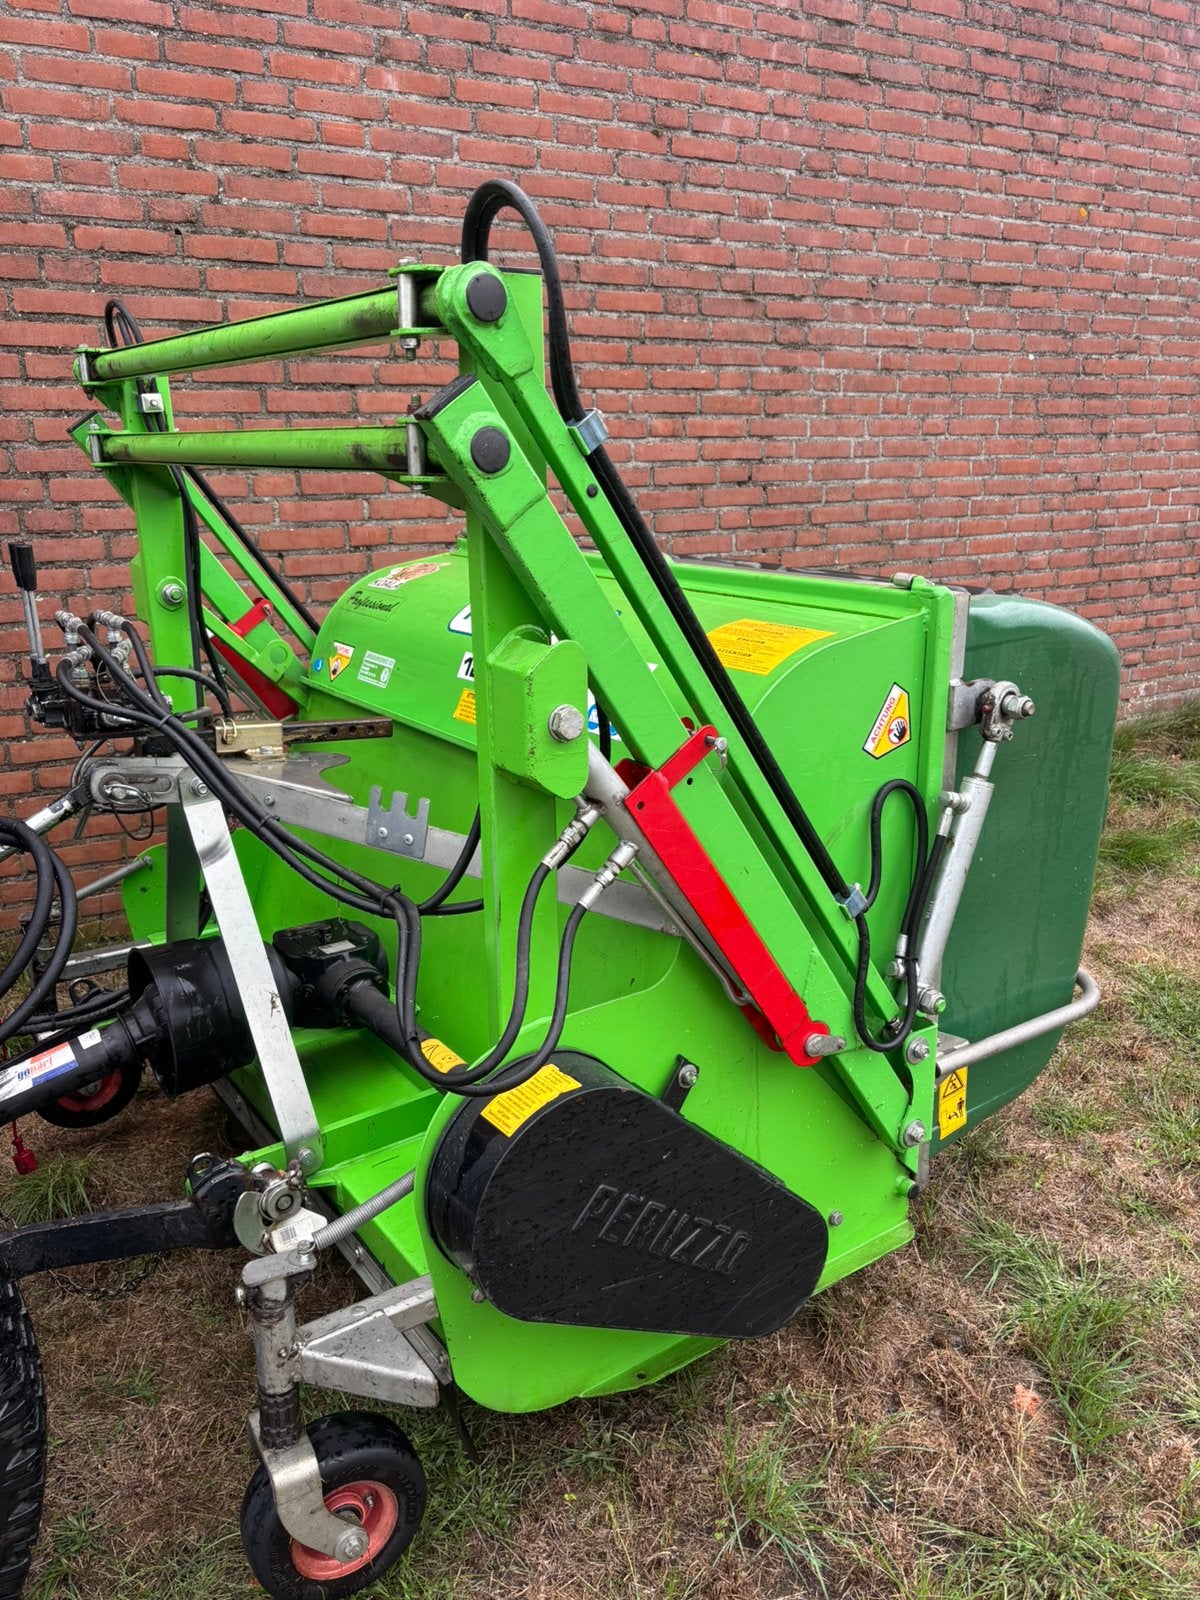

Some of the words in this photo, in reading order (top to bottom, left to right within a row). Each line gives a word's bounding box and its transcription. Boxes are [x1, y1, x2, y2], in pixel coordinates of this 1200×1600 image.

[347, 590, 400, 612] Professional
[870, 696, 896, 744] ACHTUNG
[571, 1184, 751, 1275] PERUZZO
